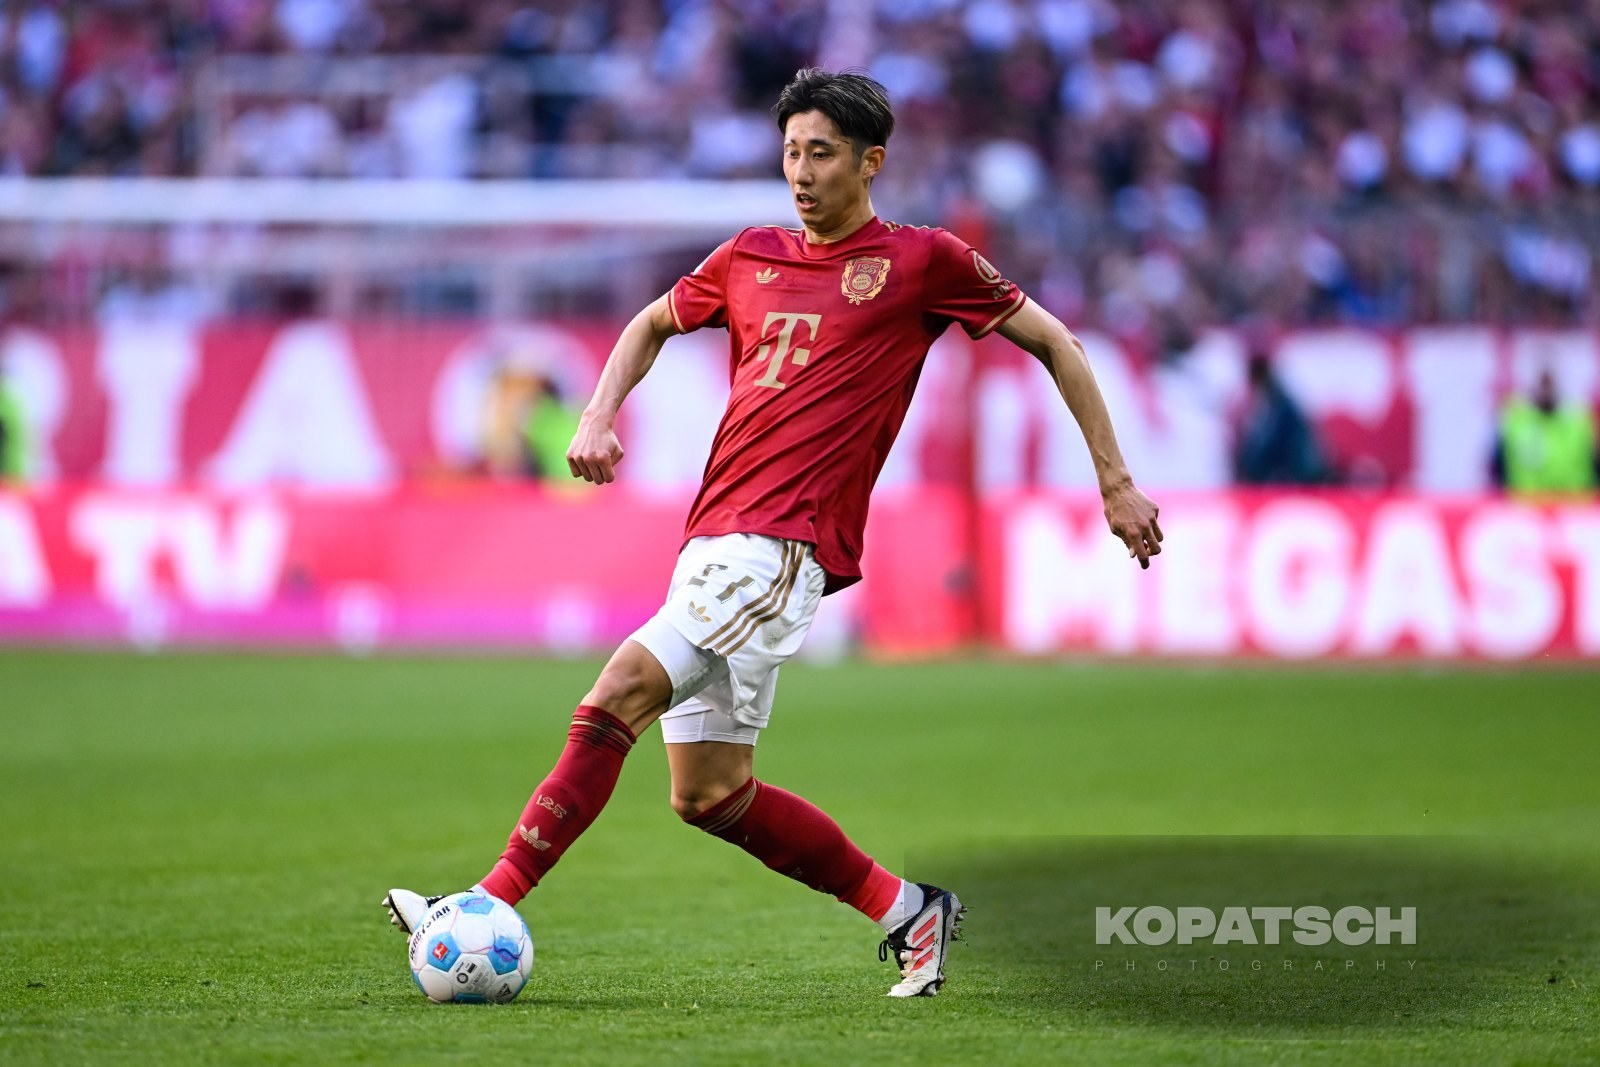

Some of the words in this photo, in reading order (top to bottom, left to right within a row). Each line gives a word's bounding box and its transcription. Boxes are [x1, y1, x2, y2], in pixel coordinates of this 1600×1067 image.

[752, 311, 822, 390] T
[68, 498, 290, 608] TV
[535, 794, 567, 819] 125
